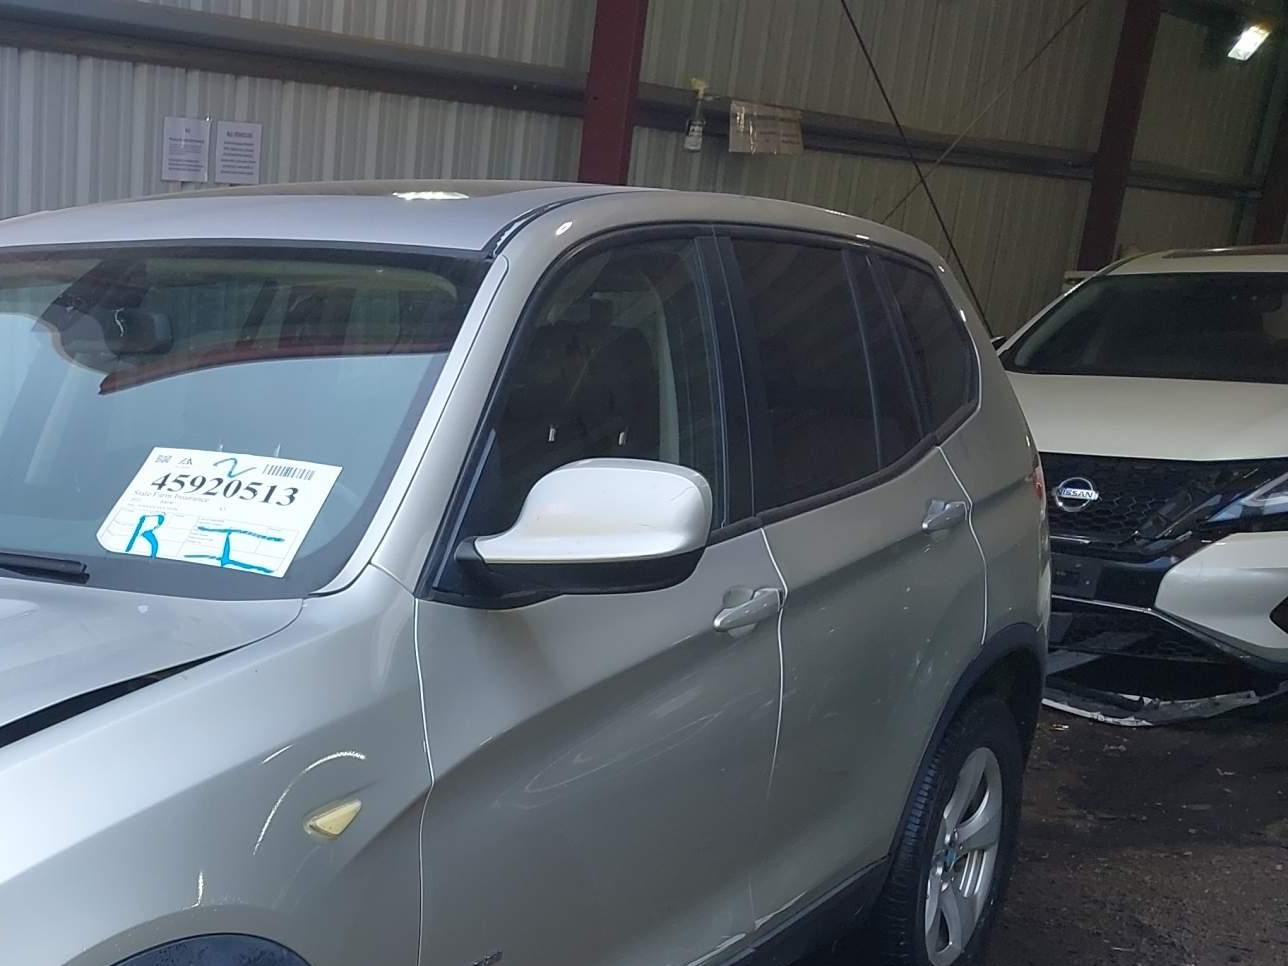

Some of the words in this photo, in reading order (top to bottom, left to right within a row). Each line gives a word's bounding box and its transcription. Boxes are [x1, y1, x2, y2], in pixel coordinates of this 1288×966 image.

[150, 472, 300, 507] 45920513
[1056, 487, 1095, 499] NISSAN
[125, 513, 166, 559] R
